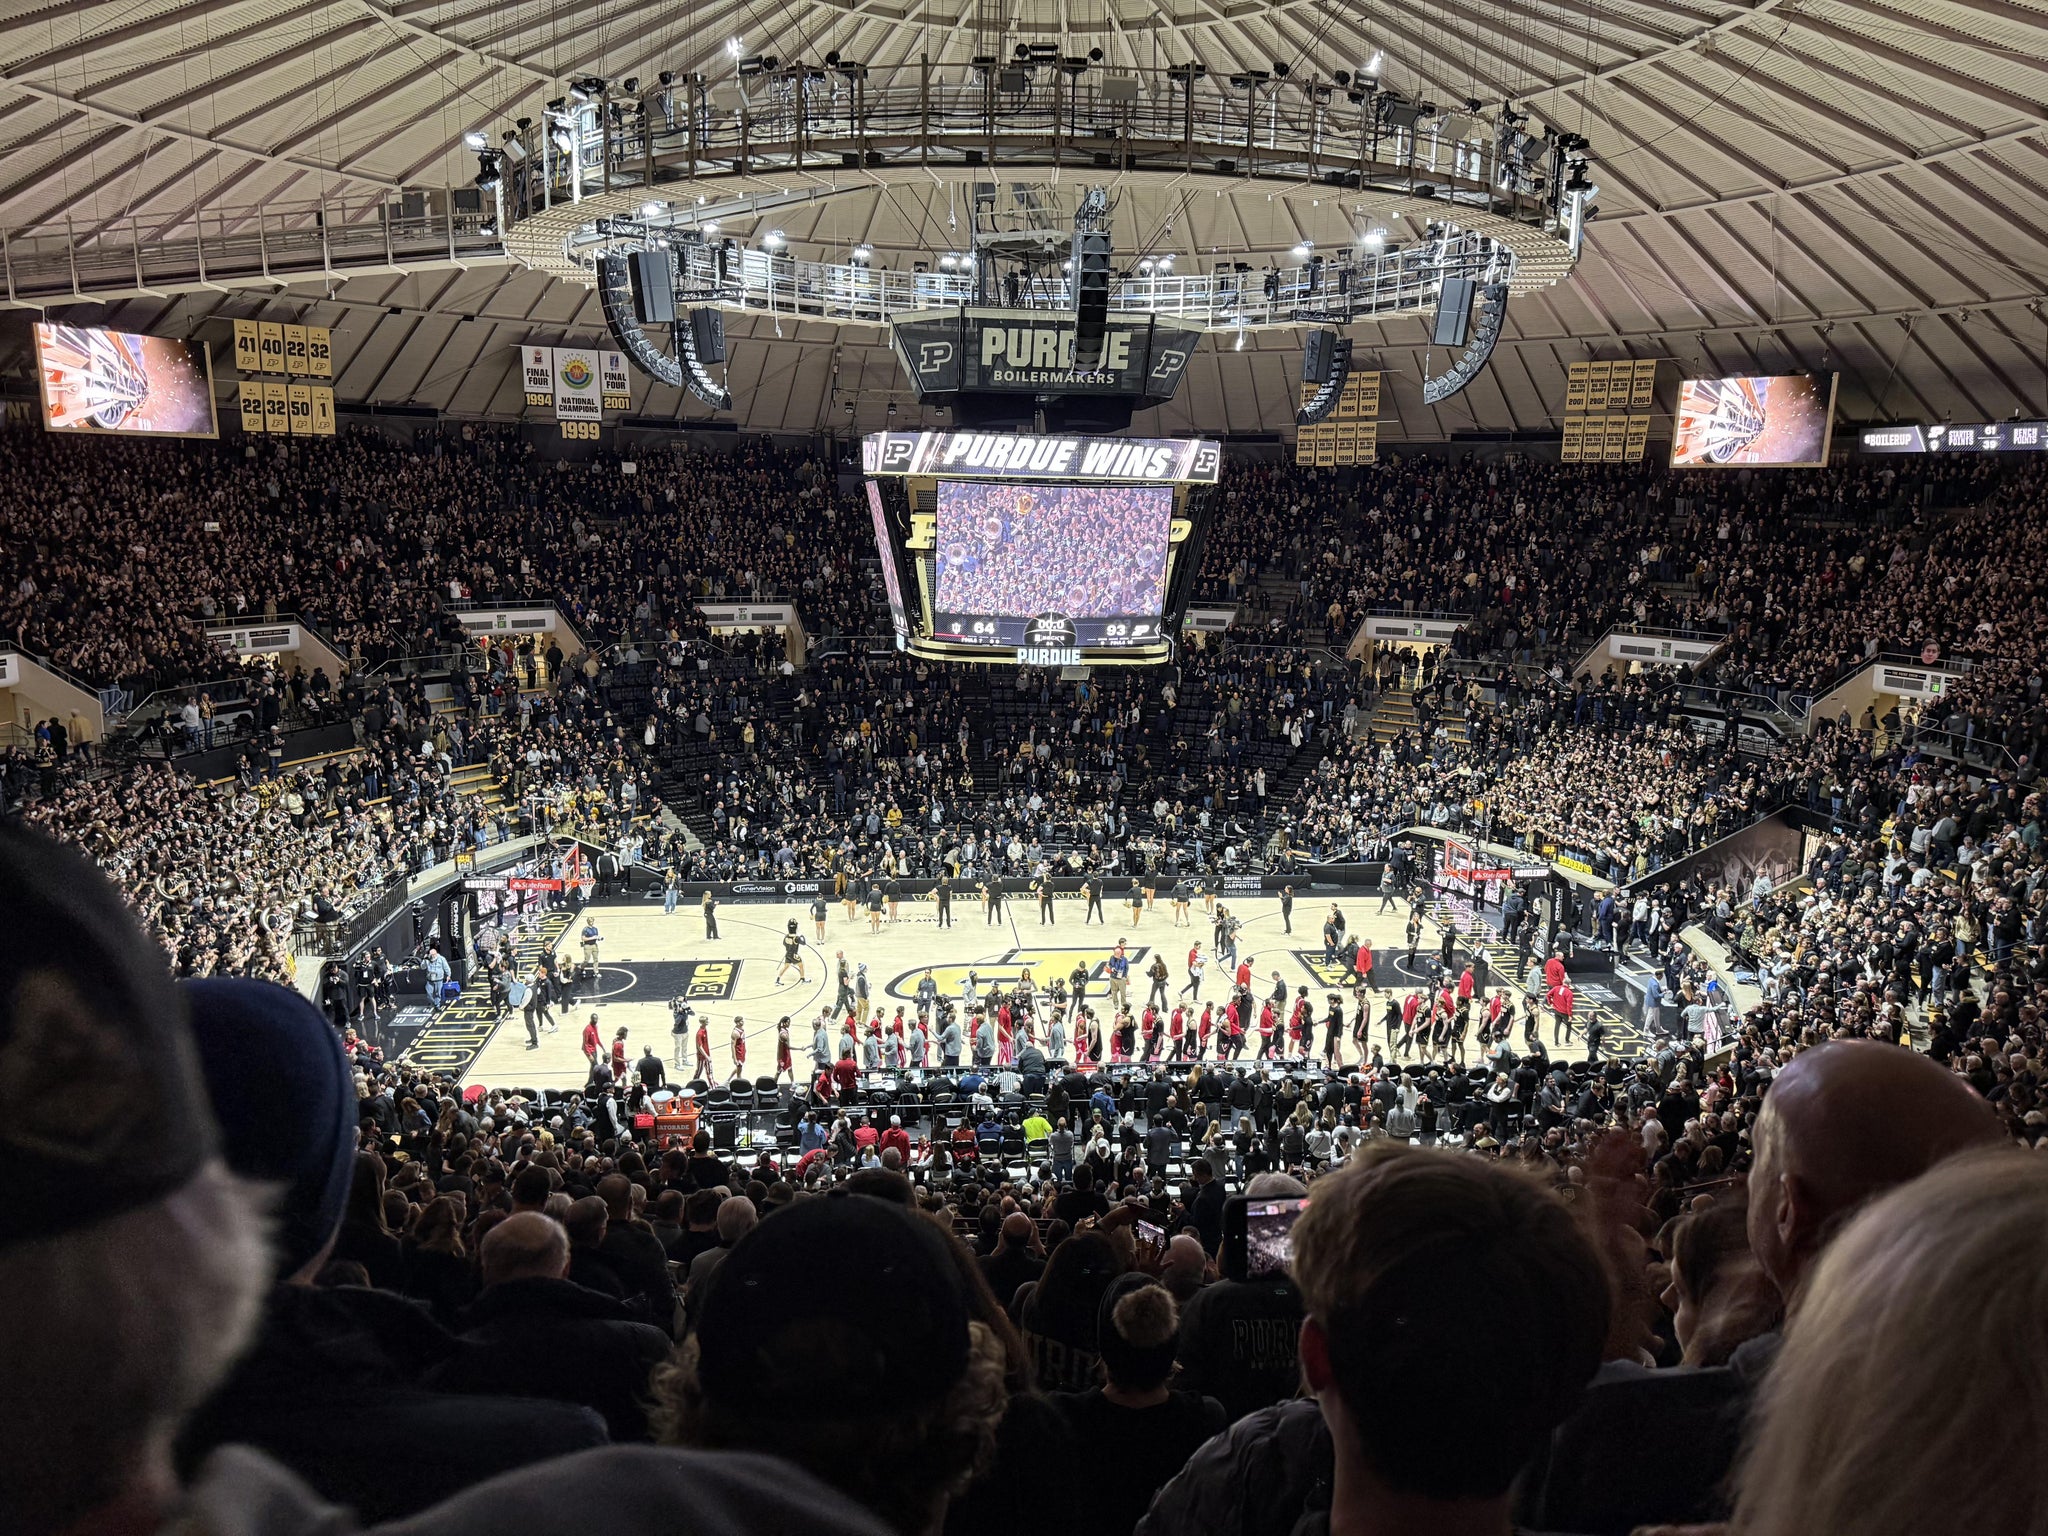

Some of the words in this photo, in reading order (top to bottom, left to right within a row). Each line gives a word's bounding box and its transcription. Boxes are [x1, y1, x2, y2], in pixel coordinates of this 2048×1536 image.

[238, 336, 256, 352] 41
[262, 338, 282, 354] 40
[287, 341, 305, 357] 22
[310, 343, 328, 359] 32
[918, 342, 953, 374] P
[1152, 350, 1186, 378] P
[526, 368, 550, 377] FINAL
[604, 372, 626, 382] FINAL
[993, 370, 1115, 384] BOILERMAKERS
[528, 377, 548, 386] FOUR
[606, 381, 626, 390] FOUR
[242, 398, 261, 414] 22
[526, 394, 552, 406] 1994
[561, 397, 594, 406] NATIONAL
[604, 397, 630, 408] 2001
[266, 400, 286, 415] 32
[290, 402, 310, 416] 50
[320, 402, 326, 417] 1
[558, 404, 598, 414] CHAMPIONS
[560, 422, 600, 440] 1999
[1984, 426, 1996, 435] 61
[2014, 428, 2038, 436] BENCH
[1864, 434, 1912, 446] #BOILERUP
[1982, 440, 1997, 449] 39
[2014, 436, 2038, 444] POINTS
[943, 435, 1077, 475] PURDUE
[1080, 442, 1172, 478] WINS
[974, 622, 995, 634] 64
[1106, 624, 1126, 636] 93
[1017, 648, 1080, 665] PURDUE
[1802, 824, 1820, 837] TIME
[1822, 831, 1832, 840] TO
[685, 963, 733, 996] BIG
